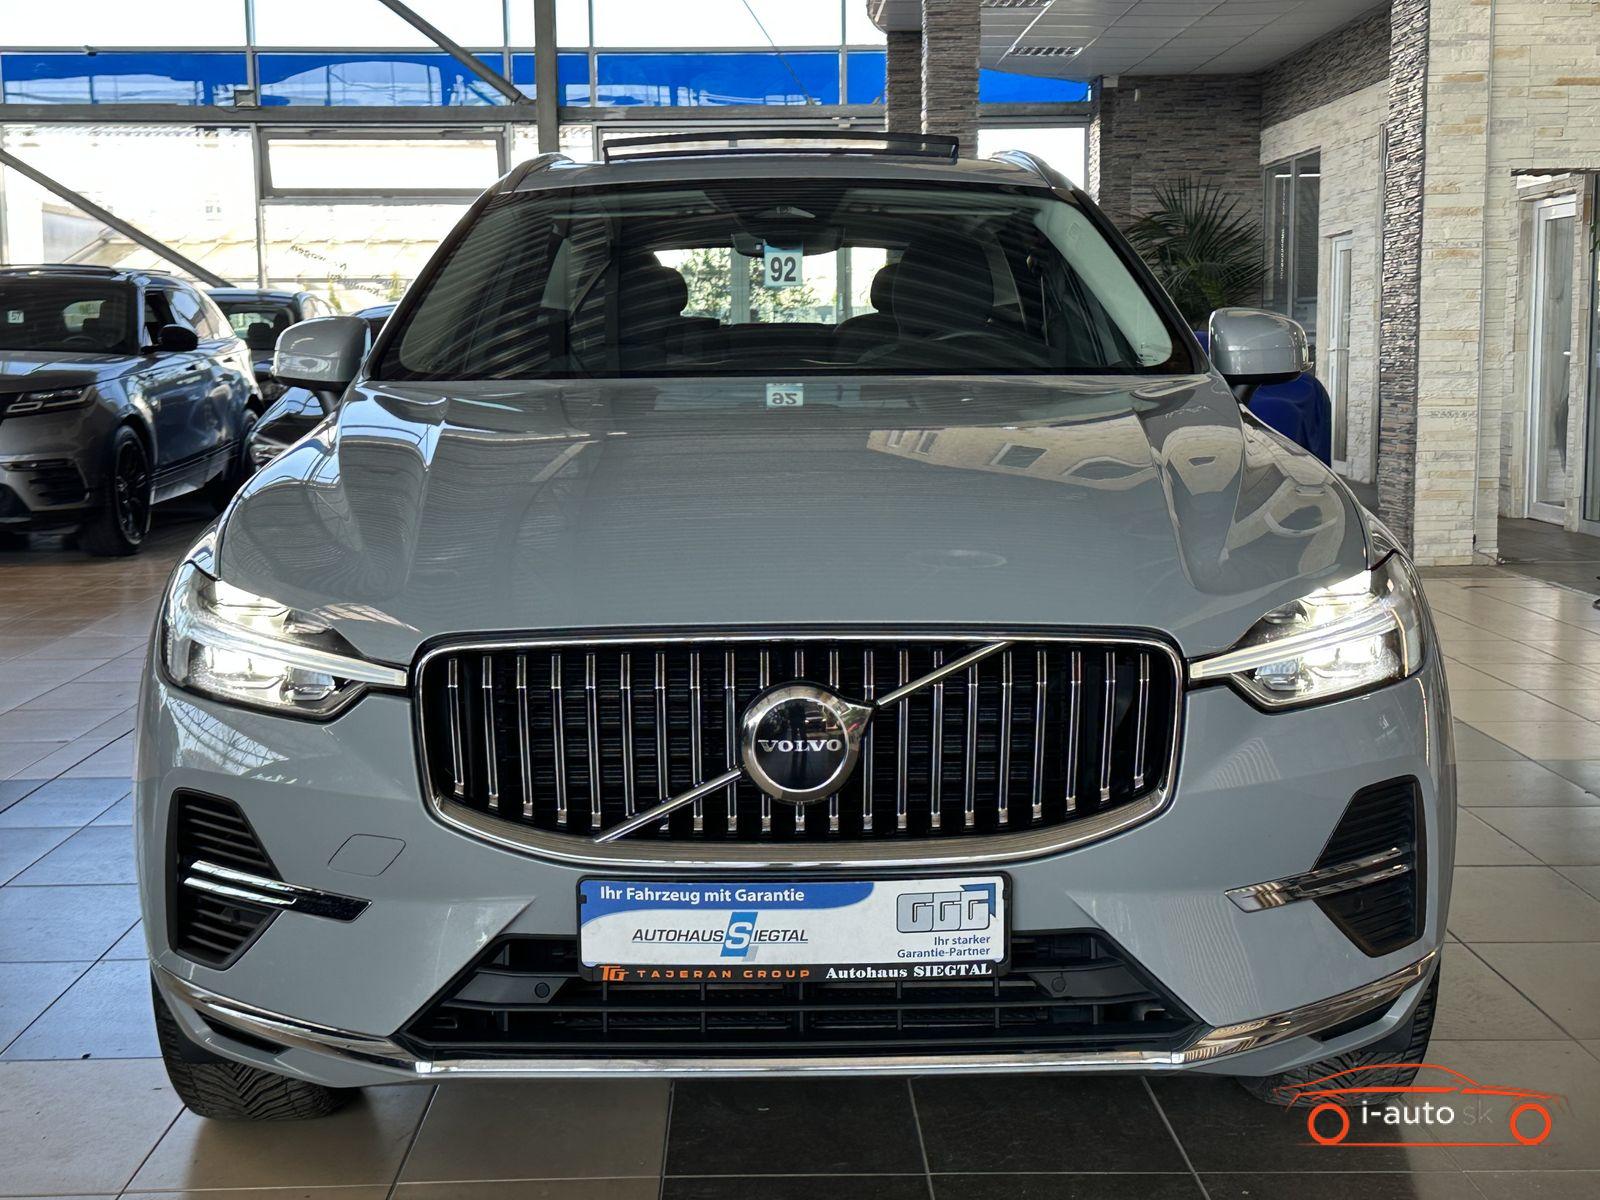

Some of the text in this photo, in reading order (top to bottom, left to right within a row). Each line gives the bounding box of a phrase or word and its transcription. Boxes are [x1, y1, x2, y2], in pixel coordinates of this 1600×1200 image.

[770, 257, 797, 282] 92
[758, 739, 842, 752] VOLVO
[601, 886, 805, 904] Ihr Fahrzeug mit Garantie
[632, 929, 724, 942] AUTOHAUS
[934, 935, 991, 946] Ihr starker
[897, 948, 991, 959] Garantie-Partner
[637, 970, 732, 979] TAJERAN
[743, 970, 810, 979] GROUP
[826, 967, 908, 980] Autohaus
[913, 964, 993, 978] SIEGTAL
